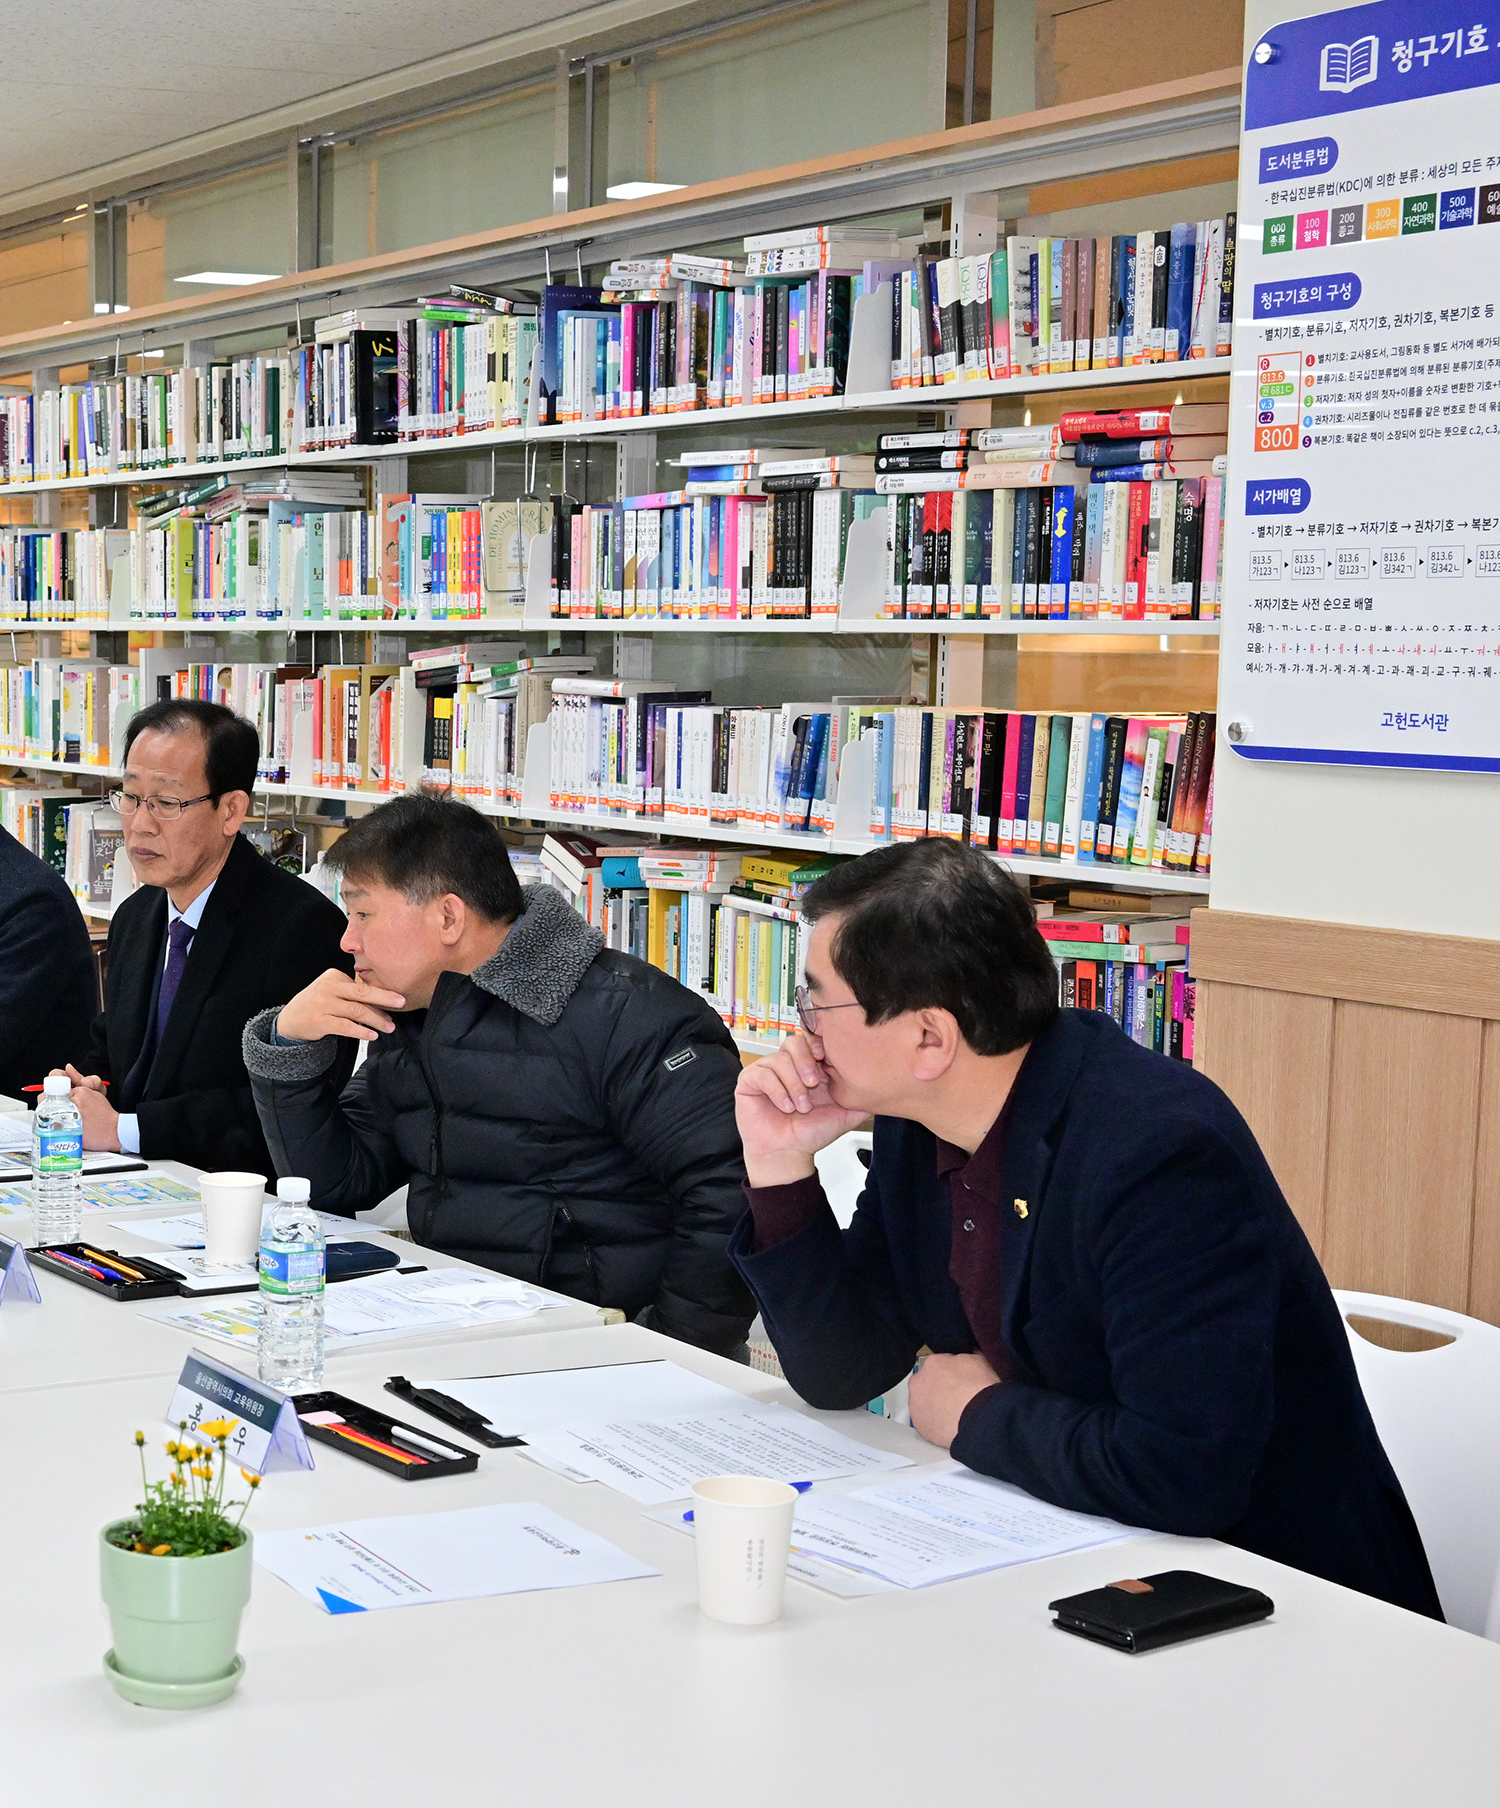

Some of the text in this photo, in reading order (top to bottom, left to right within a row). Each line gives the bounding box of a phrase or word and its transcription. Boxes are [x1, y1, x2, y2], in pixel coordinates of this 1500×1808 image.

[1391, 24, 1488, 73] 청구기호
[1266, 147, 1329, 172] 도서분류법
[1271, 159, 1481, 204] 한국십진분류법(KDC)에 의한 분류 세상의 모든
[1412, 201, 1428, 213] 400
[1449, 195, 1467, 208] 500
[1340, 212, 1355, 224] 200
[1375, 207, 1391, 218] 300
[1404, 212, 1435, 228] 자연과학
[1441, 206, 1474, 221] 기술과학
[1271, 223, 1286, 234] 000
[1305, 217, 1320, 229] 100
[1338, 224, 1355, 237] 종교
[1367, 217, 1397, 232] 사회과학
[1304, 229, 1320, 242] 철학
[1222, 237, 1236, 293] 루팡의 딸
[939, 266, 949, 303] 1Q84
[960, 264, 970, 300] 1Q84
[977, 262, 987, 302] 1Q84
[1260, 283, 1353, 310] 청구기호의 구성
[1265, 304, 1495, 341] 별치기호, 분류기호, 저자기호, 권차기호, 복본기호 등
[1318, 353, 1347, 365] 별치기호:
[1350, 347, 1388, 362] 교사용도서,
[1390, 344, 1421, 358] 그림동화
[1423, 344, 1431, 355] 등
[1433, 341, 1448, 354] 별도
[1451, 338, 1474, 352] 서가에
[1262, 360, 1269, 370] R
[1261, 372, 1283, 383] 813.6
[1316, 362, 1450, 385] 분류기호: 한국십진분류법에 의해 분류된
[1262, 385, 1270, 396] 권
[1315, 380, 1473, 405] 저자기호: 저자 성의 첫자+이름을 숫자로 변환한
[1260, 400, 1273, 410] v.3
[1259, 413, 1273, 423] c.2
[1315, 402, 1486, 425] 권차기호: 시리즈물이나 전집류를 같은 번호로 한 데
[1260, 427, 1293, 449] 800
[1314, 433, 1345, 446] 복본기호:
[1346, 431, 1368, 444] 똑같은
[1370, 429, 1385, 442] 책이
[1386, 427, 1417, 441] 소장되어
[1419, 426, 1442, 440] 있다는
[1444, 424, 1467, 437] 뜻으로
[1253, 486, 1302, 507] 서가배열
[1184, 492, 1195, 522] 숙명
[1257, 525, 1293, 538] 별치기호
[1307, 523, 1345, 537] 분류기호
[1359, 521, 1399, 535] 저자기호
[1414, 519, 1455, 533] 권차기호
[489, 545, 497, 558] DE
[1295, 553, 1314, 564] 813.5
[1339, 552, 1359, 563] 813.6
[1384, 552, 1405, 562] 813.6
[1431, 551, 1453, 562] 813.6
[1252, 554, 1272, 565] 813.5
[1254, 597, 1373, 612] 저자기호는 사전 순으로 배열
[1247, 622, 1265, 634] 자음:
[1247, 643, 1265, 655] 모음:
[1246, 663, 1264, 674] 예시:
[1381, 712, 1449, 732] 고헌도서관
[1184, 719, 1194, 758] ORIGIN
[1196, 719, 1206, 758] ORIGIN
[95, 838, 114, 858] 낯선
[1137, 986, 1146, 1030] 웨어하우스
[54, 1142, 78, 1152] 삼다수
[195, 1372, 265, 1417] 울산광역시의회 교육위원장
